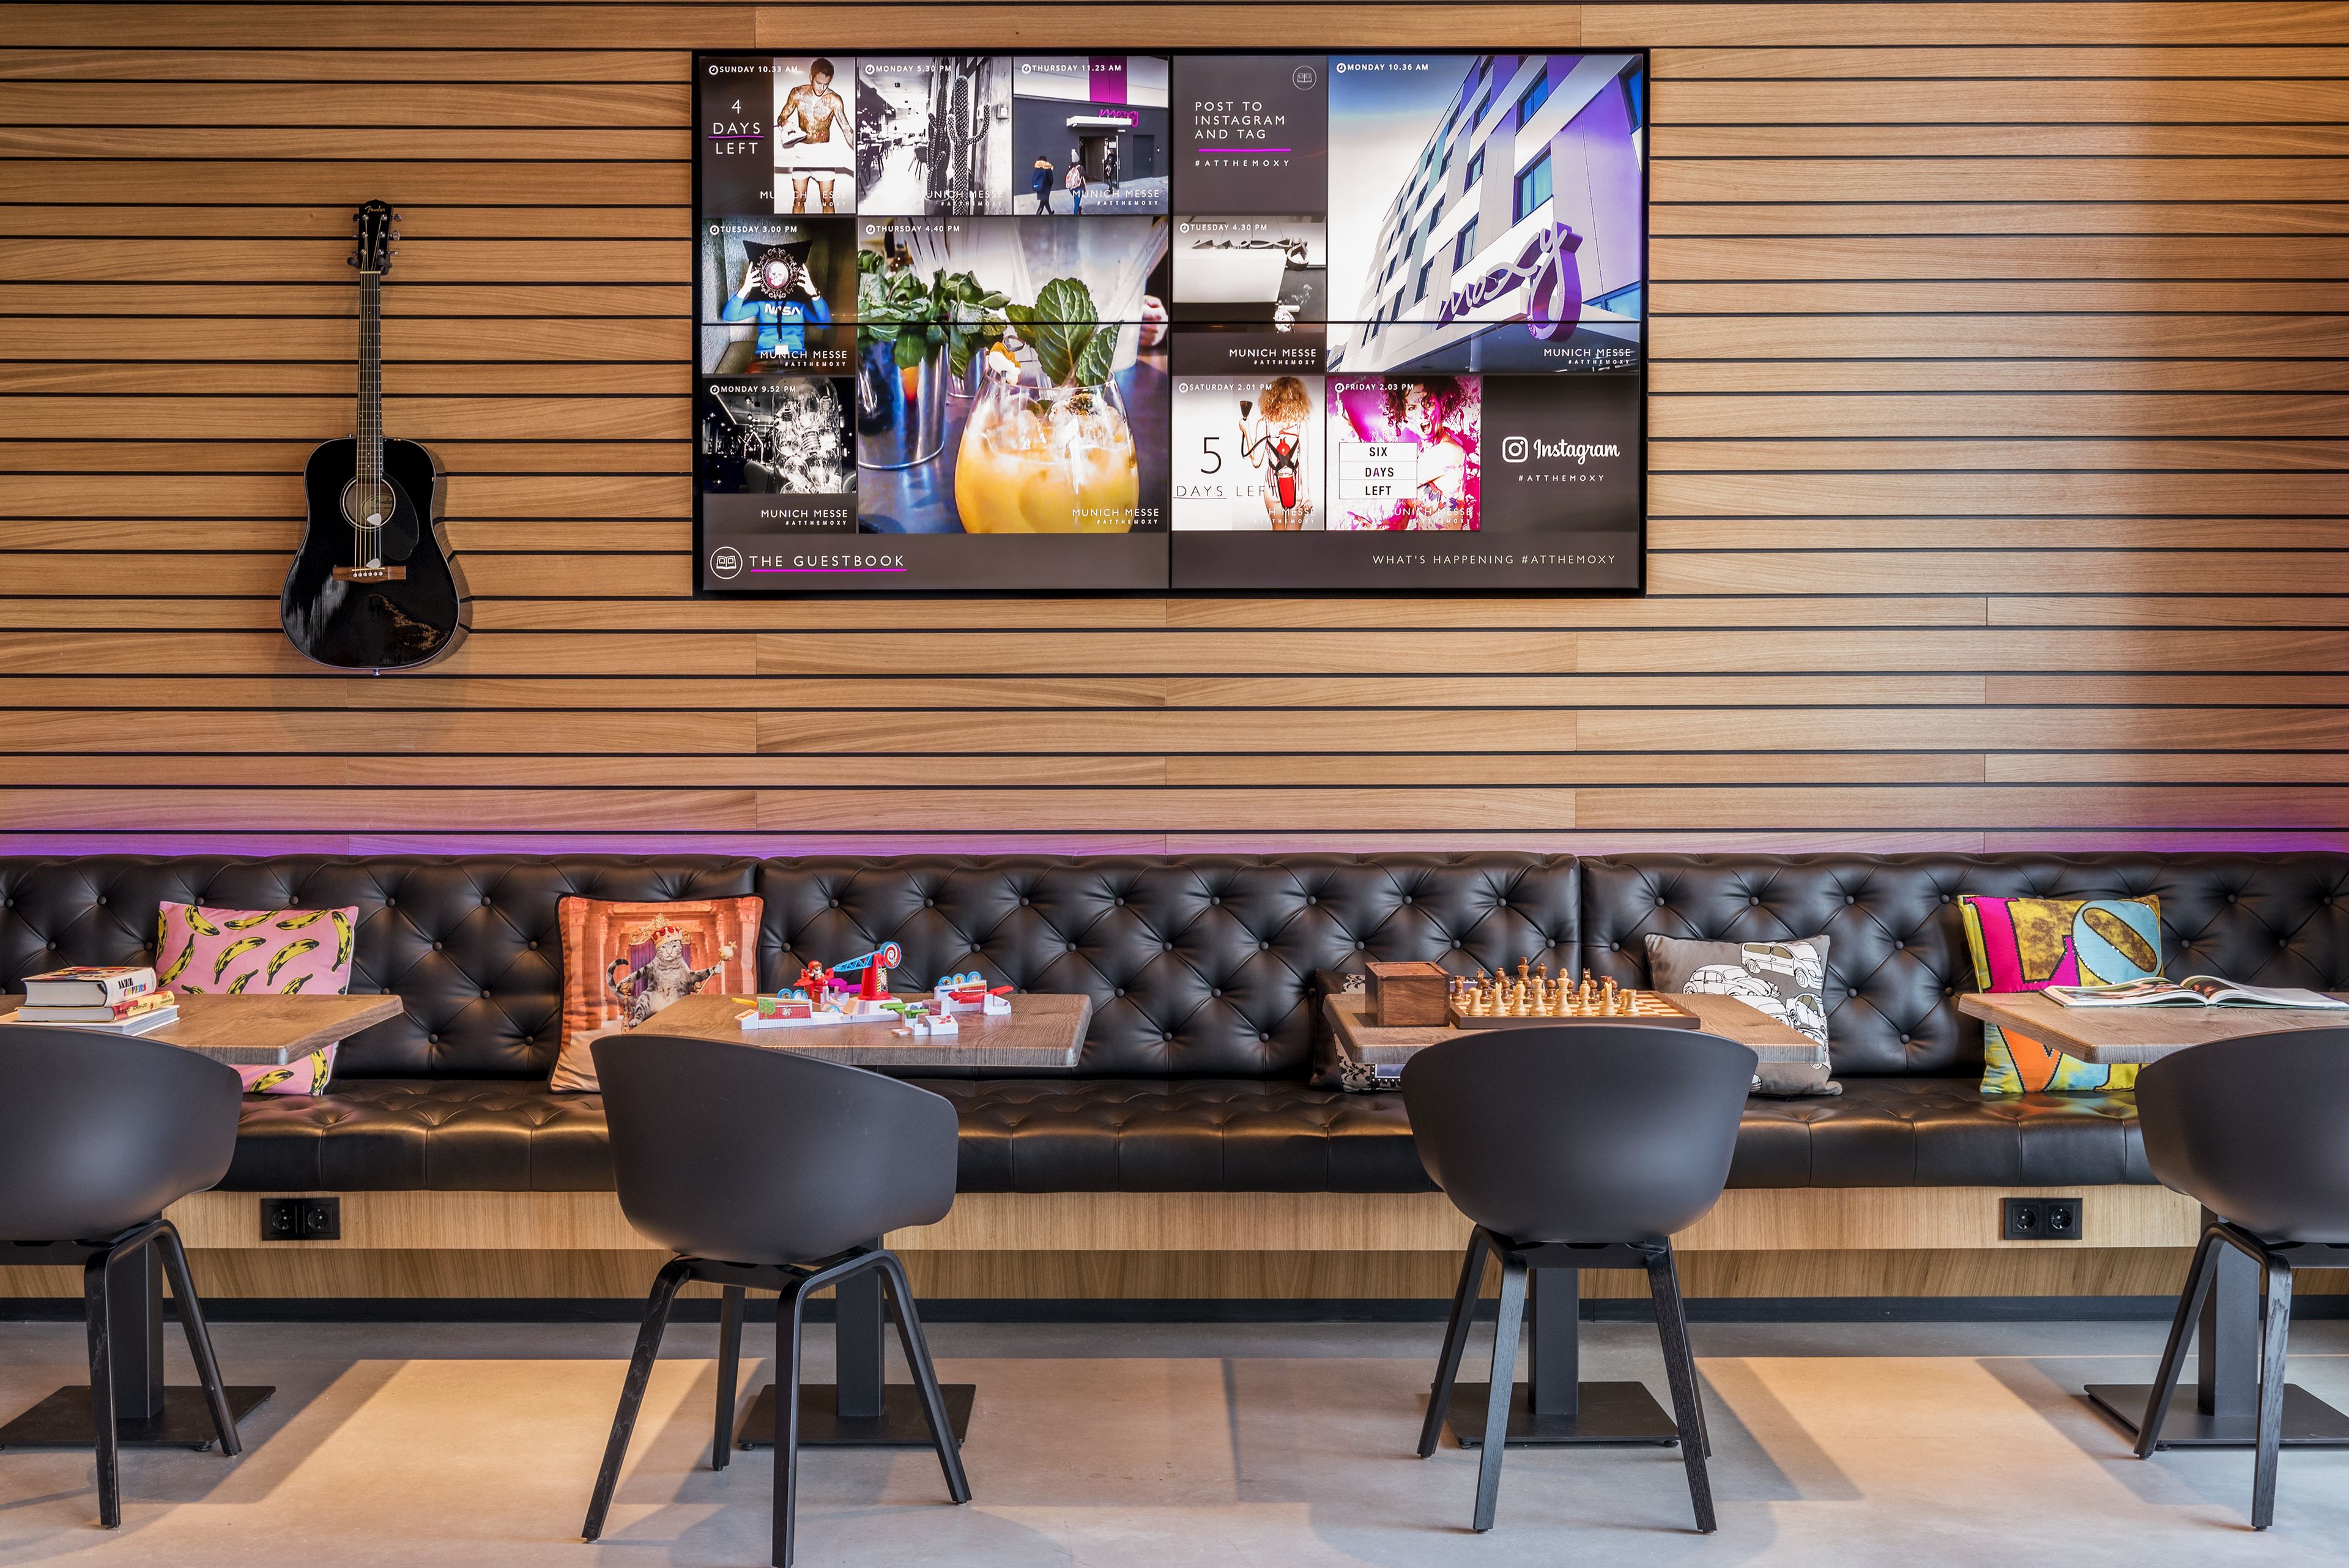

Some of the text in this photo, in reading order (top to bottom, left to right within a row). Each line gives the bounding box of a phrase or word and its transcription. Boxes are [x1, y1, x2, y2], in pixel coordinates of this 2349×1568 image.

[731, 99, 741, 114] 4
[1195, 102, 1263, 111] POST TO
[1195, 115, 1285, 125] INSTAGRAM
[713, 122, 761, 135] DAYS
[1195, 129, 1266, 139] AND TAG
[716, 143, 759, 154] LEFT
[1072, 190, 1160, 198] MUNICH MESSE
[364, 205, 385, 214] Fender
[760, 351, 847, 359] MUNICH MESSE
[1229, 349, 1316, 357] MUNICH MESSE
[1544, 348, 1631, 357] MUNICH MESSE
[1201, 437, 1222, 474] 5
[1369, 447, 1388, 457] SIX
[1533, 439, 1620, 465] Instagram
[1365, 467, 1395, 478] DAYS
[1176, 486, 1223, 497] DAYS
[1365, 486, 1392, 496] LEFT
[761, 510, 808, 518] MUNICH
[1072, 508, 1159, 517] MUNICH MESSE
[1282, 508, 1316, 516] MESSE
[749, 555, 905, 568] THE GUESTBOOK
[1372, 554, 1617, 564] WHAT'S HAPPENING #ATTHEMOXY
[124, 983, 147, 997] COVERS
